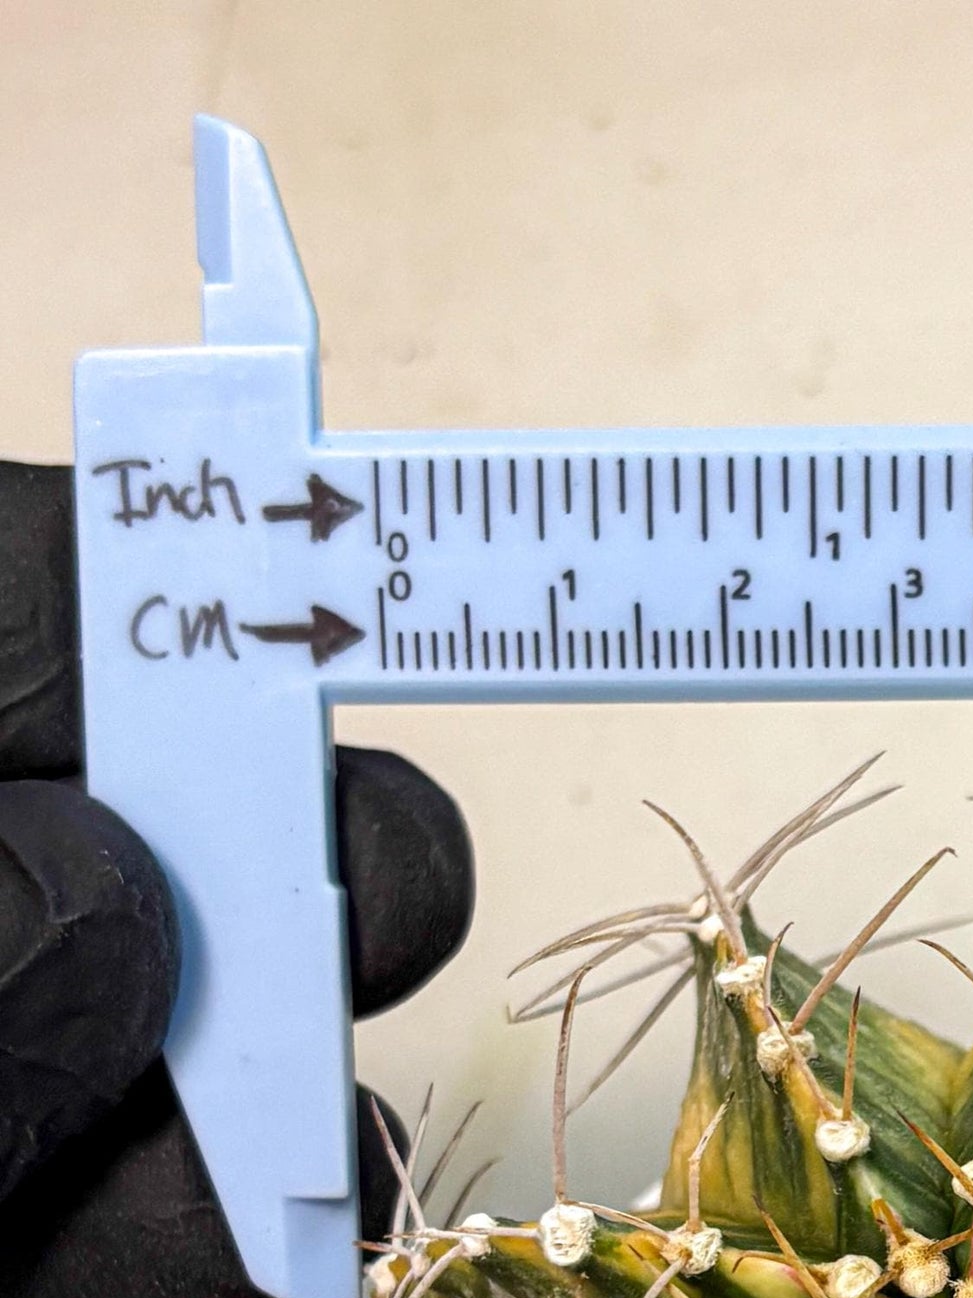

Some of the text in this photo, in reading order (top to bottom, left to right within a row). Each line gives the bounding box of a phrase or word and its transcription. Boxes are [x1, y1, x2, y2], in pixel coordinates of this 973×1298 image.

[91, 458, 246, 528] Inch
[386, 531, 410, 563] 0
[824, 531, 842, 561] 1
[388, 570, 413, 602] 0
[561, 568, 577, 601] 1
[730, 568, 752, 601] 2
[903, 568, 925, 599] 3
